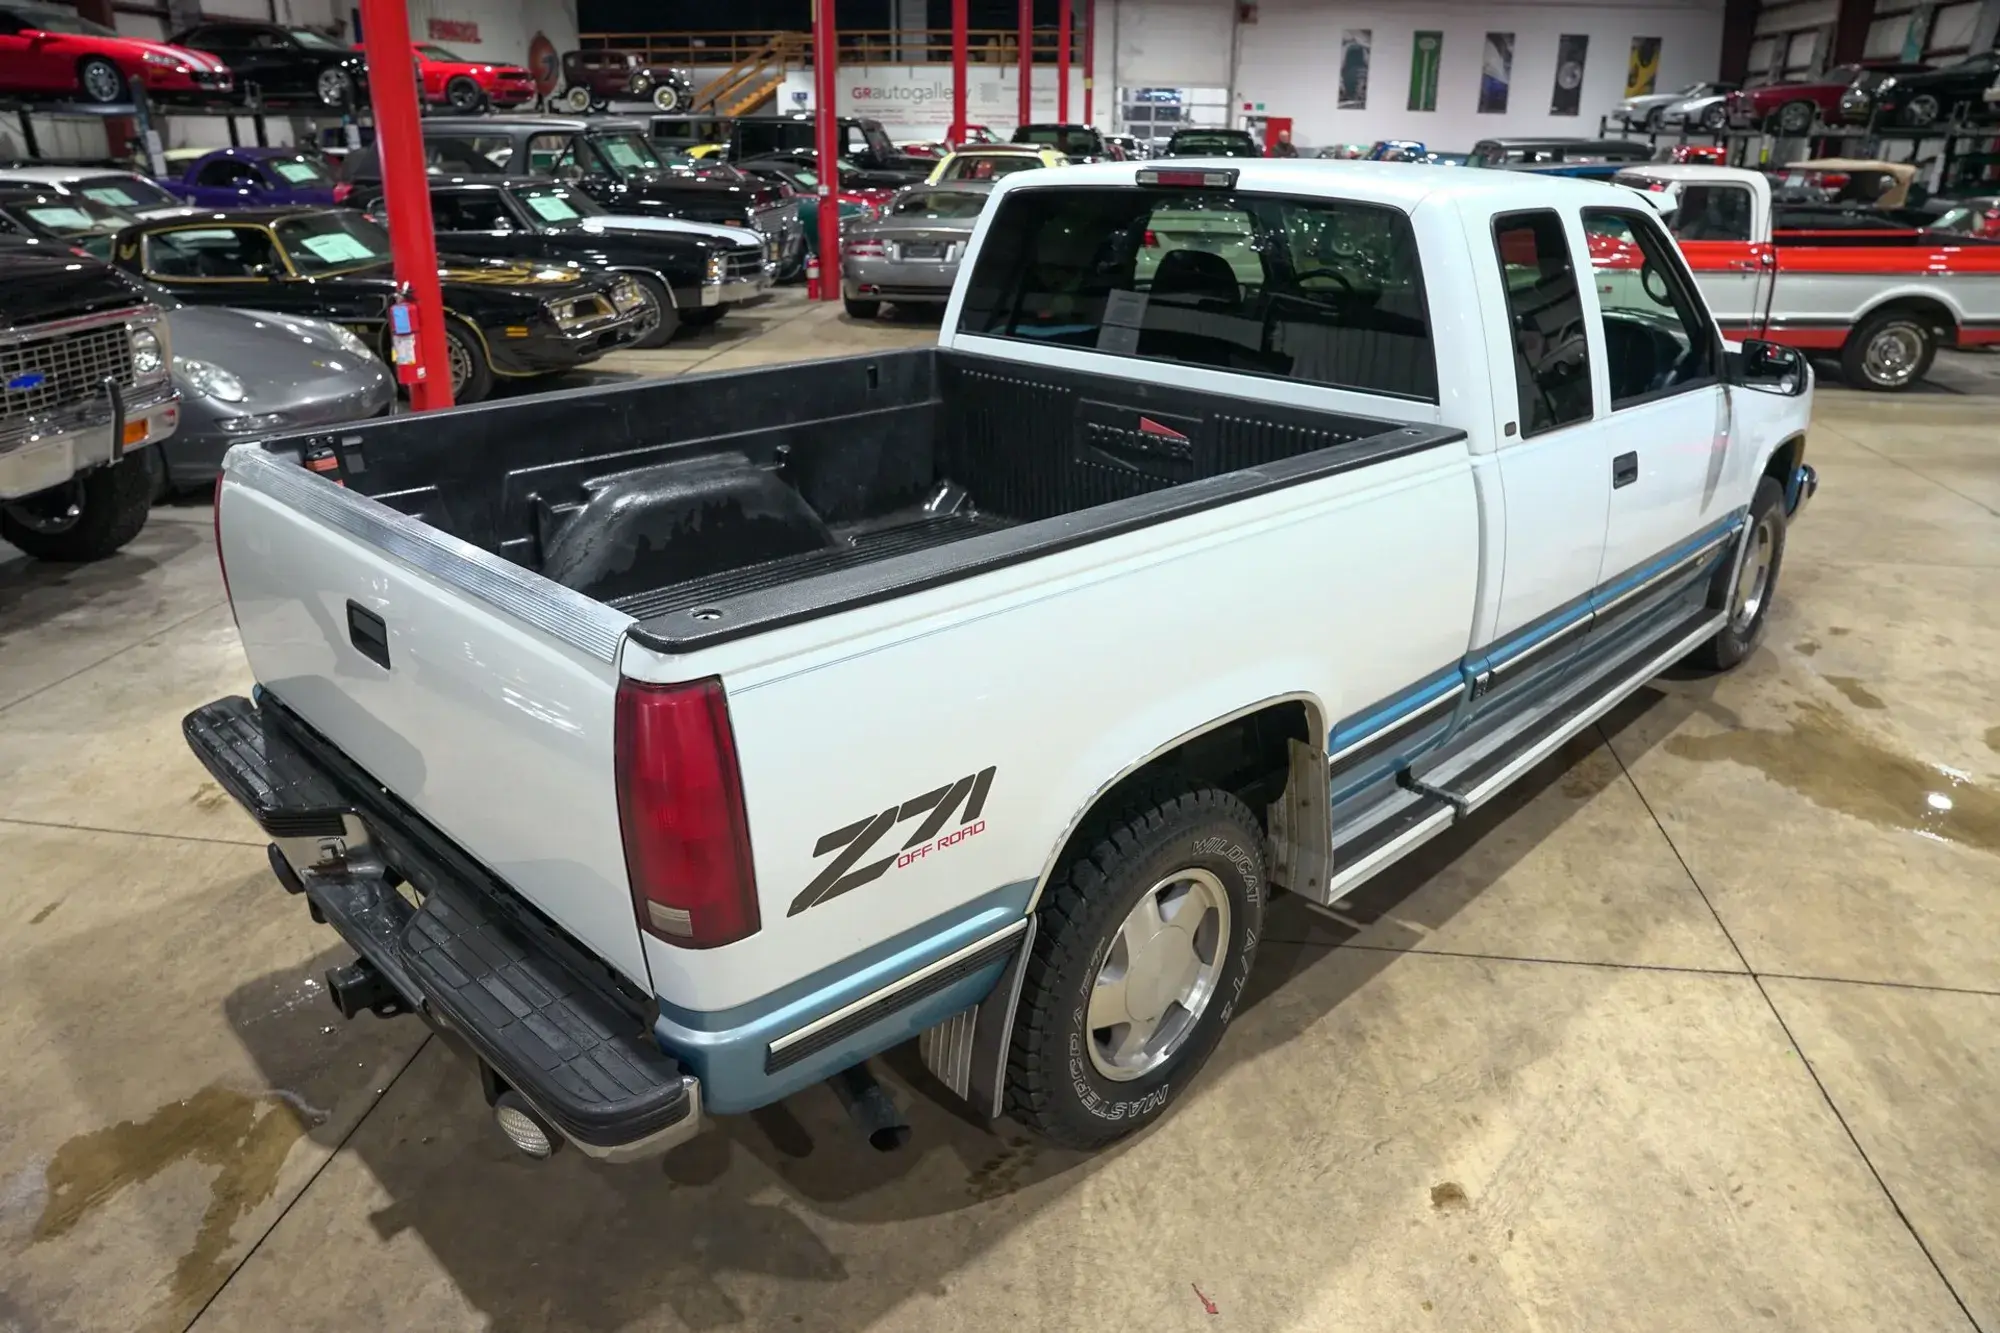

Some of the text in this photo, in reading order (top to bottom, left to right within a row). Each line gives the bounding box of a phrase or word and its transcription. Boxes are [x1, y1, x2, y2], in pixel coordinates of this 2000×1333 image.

[852, 82, 972, 104] GRautogalley
[787, 766, 997, 918] Z71
[898, 820, 985, 868] OFF ROAD
[1192, 836, 1260, 908] WILDCAT
